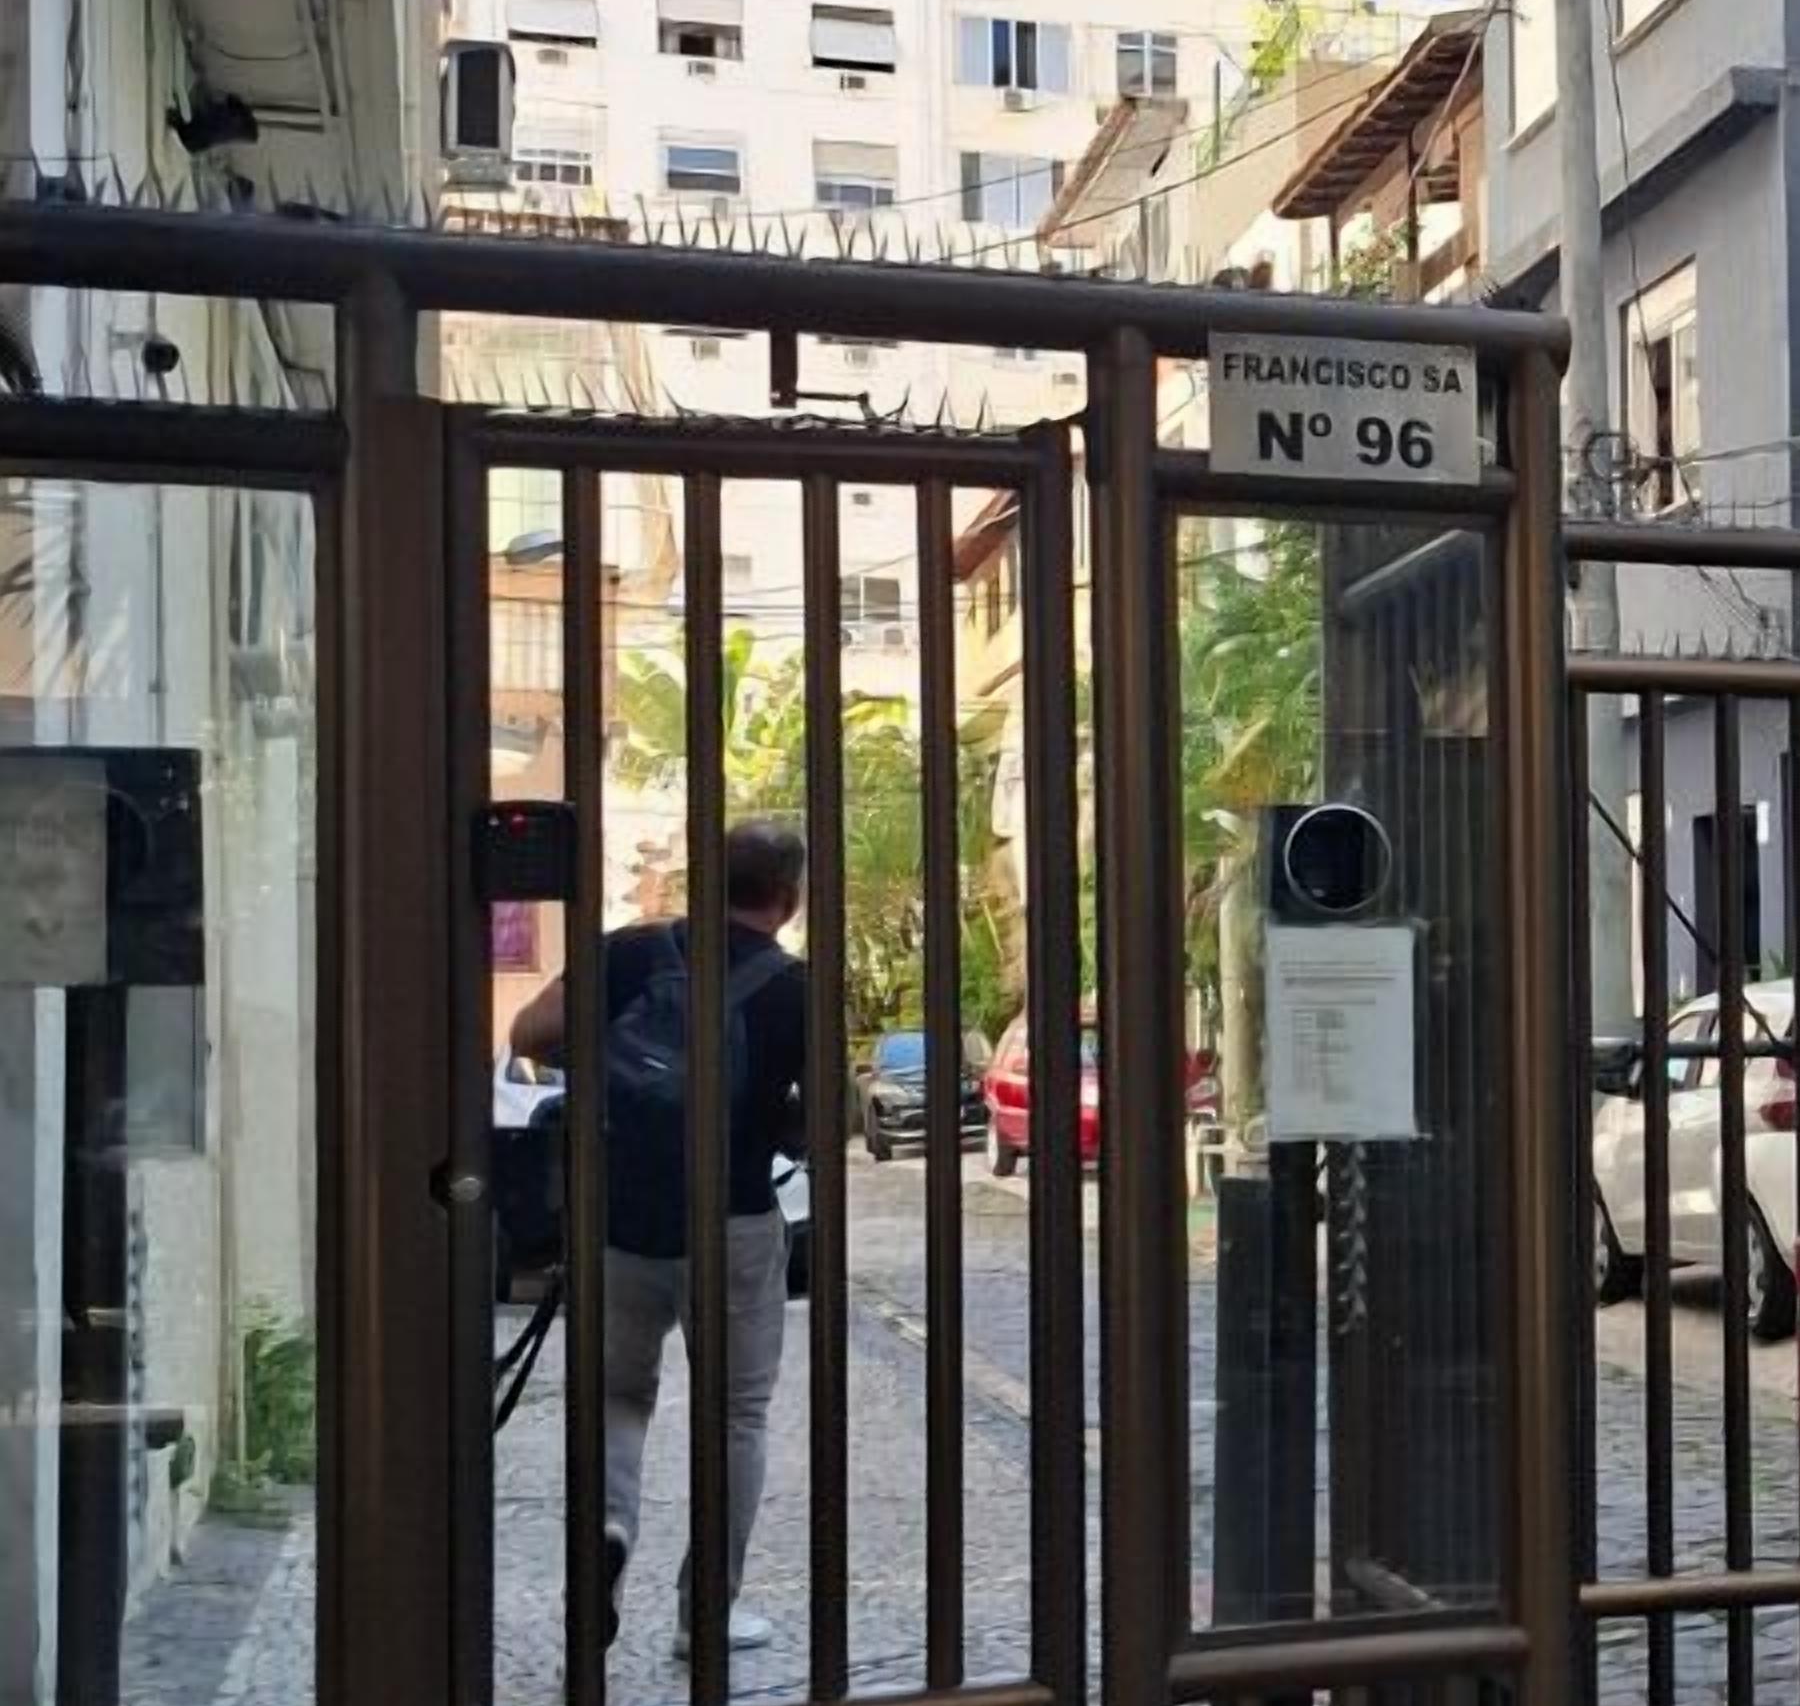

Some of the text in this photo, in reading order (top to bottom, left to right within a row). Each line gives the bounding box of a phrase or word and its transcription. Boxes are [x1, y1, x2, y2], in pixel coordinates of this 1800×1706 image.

[1223, 353, 1411, 390] FRANCISCO
[1258, 411, 1433, 468] Nº 96
